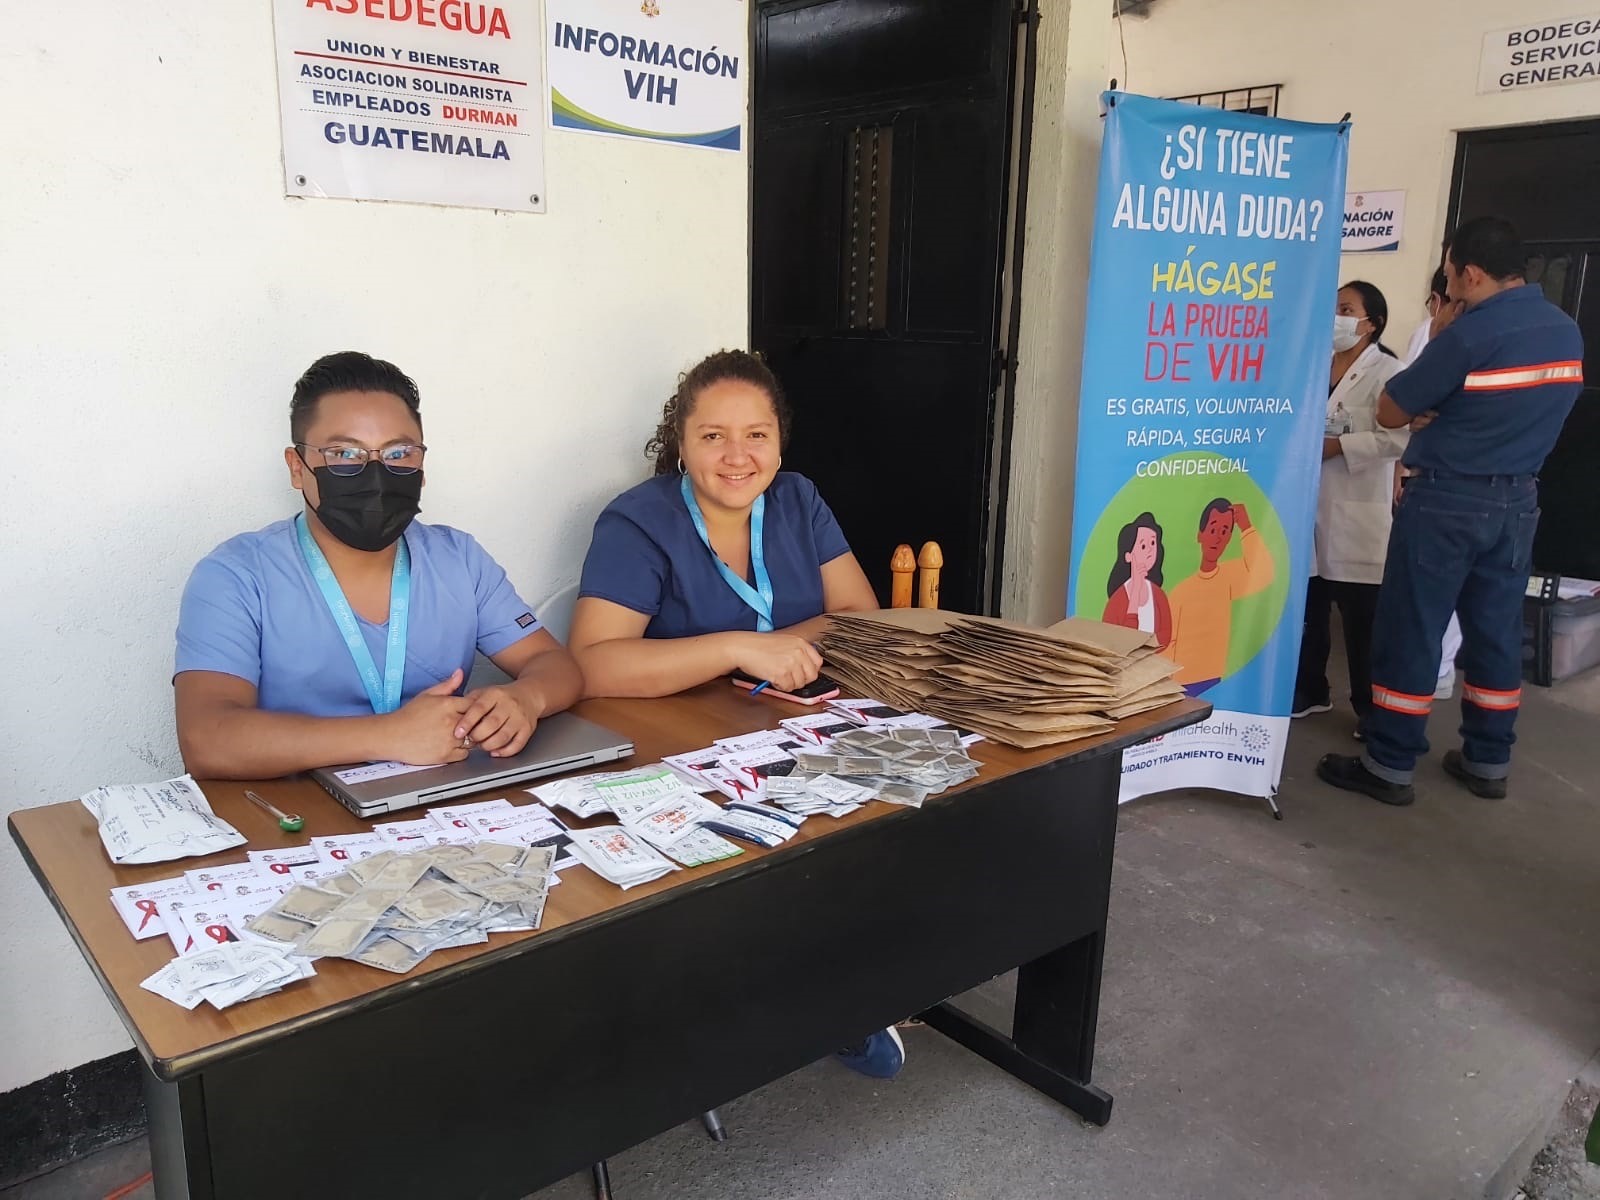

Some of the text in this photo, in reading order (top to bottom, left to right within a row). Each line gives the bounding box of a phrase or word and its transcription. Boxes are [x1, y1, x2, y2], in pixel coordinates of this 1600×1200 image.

[327, 39, 499, 75] UNION Y BIENESTAR
[555, 22, 738, 79] INFORMACIÓN
[301, 64, 512, 103] ASOCIACION SOLIDARISTA
[624, 70, 677, 105] VIH
[1499, 61, 1600, 87] GENERA
[312, 89, 517, 127] EMPLEADOS DURMAN
[324, 121, 510, 161] GUATEMALA
[1160, 125, 1293, 180] ¿SI TIENE
[1112, 183, 1324, 243] ALGUNA DUDA?
[1341, 225, 1394, 238] SANGRE
[1152, 245, 1277, 301] HÁGASE
[1147, 302, 1268, 338] LA PRUEBA
[1144, 342, 1265, 382] DE VIH
[1106, 398, 1294, 418] ES GRATIS, VOLUNTARIA
[1126, 426, 1267, 447] RÁPIDA, SEGURA Y
[1136, 458, 1249, 478] CONFIDENCIAL
[1158, 750, 1224, 766] TRATAMIENTO
[1227, 752, 1244, 763] EN
[1245, 756, 1265, 766] VIH
